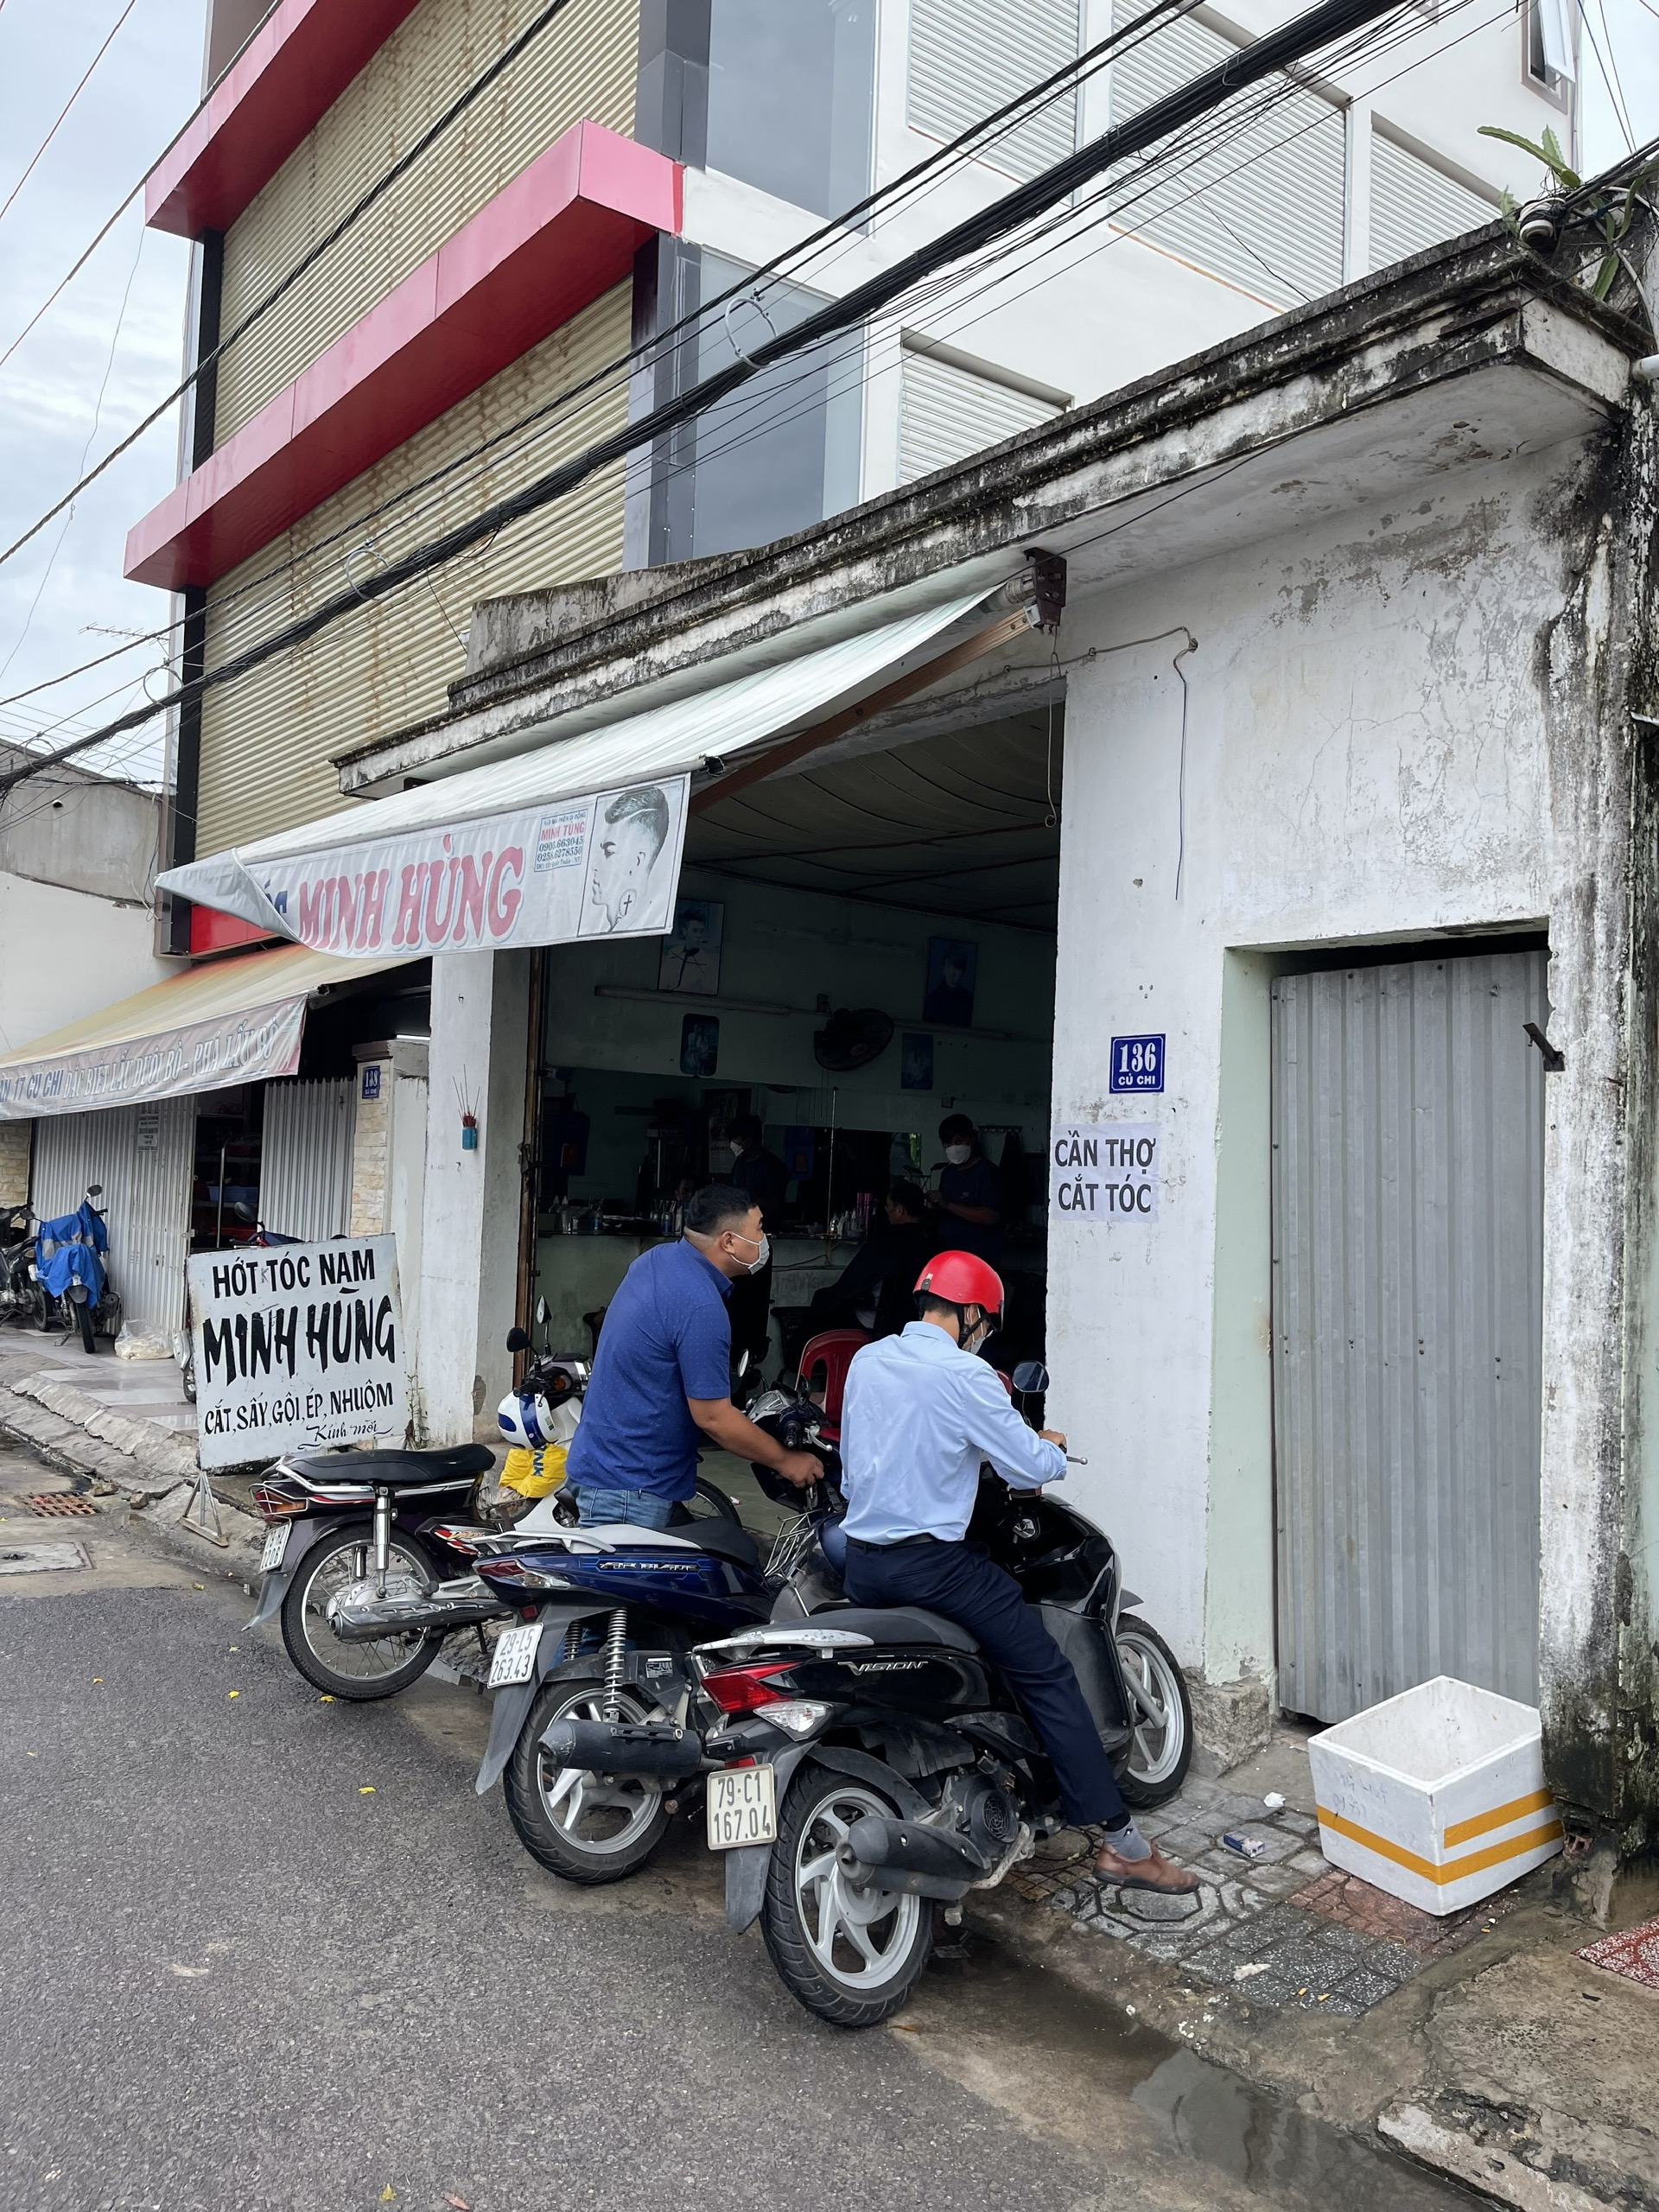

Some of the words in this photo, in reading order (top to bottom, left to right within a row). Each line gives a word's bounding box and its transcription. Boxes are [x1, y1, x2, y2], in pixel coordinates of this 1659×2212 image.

[541, 826, 560, 841] MINH
[563, 821, 584, 836] TÙNG
[298, 868, 391, 950] MINH
[391, 833, 524, 945] HÙNG
[1119, 1042, 1157, 1073] 136
[13, 1076, 27, 1102] 17
[27, 1064, 43, 1100] CỦ
[42, 1069, 65, 1098] CHI
[1118, 1073, 1134, 1086] CỦ
[1136, 1075, 1156, 1085] CHI
[1054, 1129, 1098, 1167] CẦN
[1104, 1137, 1157, 1175] THỢ
[1058, 1173, 1099, 1211] CẮT
[1104, 1173, 1153, 1212] TÓC
[212, 1255, 258, 1300] HỚT
[265, 1250, 311, 1293] TÓC
[319, 1248, 376, 1286] NAM
[202, 1305, 299, 1387] MINH
[329, 1378, 394, 1413] NHUỘM
[306, 1421, 347, 1443] Kính
[349, 1419, 378, 1436] mời
[499, 1628, 536, 1656] 29-L5
[490, 1653, 531, 1684] 263.43
[836, 1660, 929, 1677] VISION
[717, 1770, 762, 1809] 79-C1
[713, 1804, 772, 1843] 167.04
